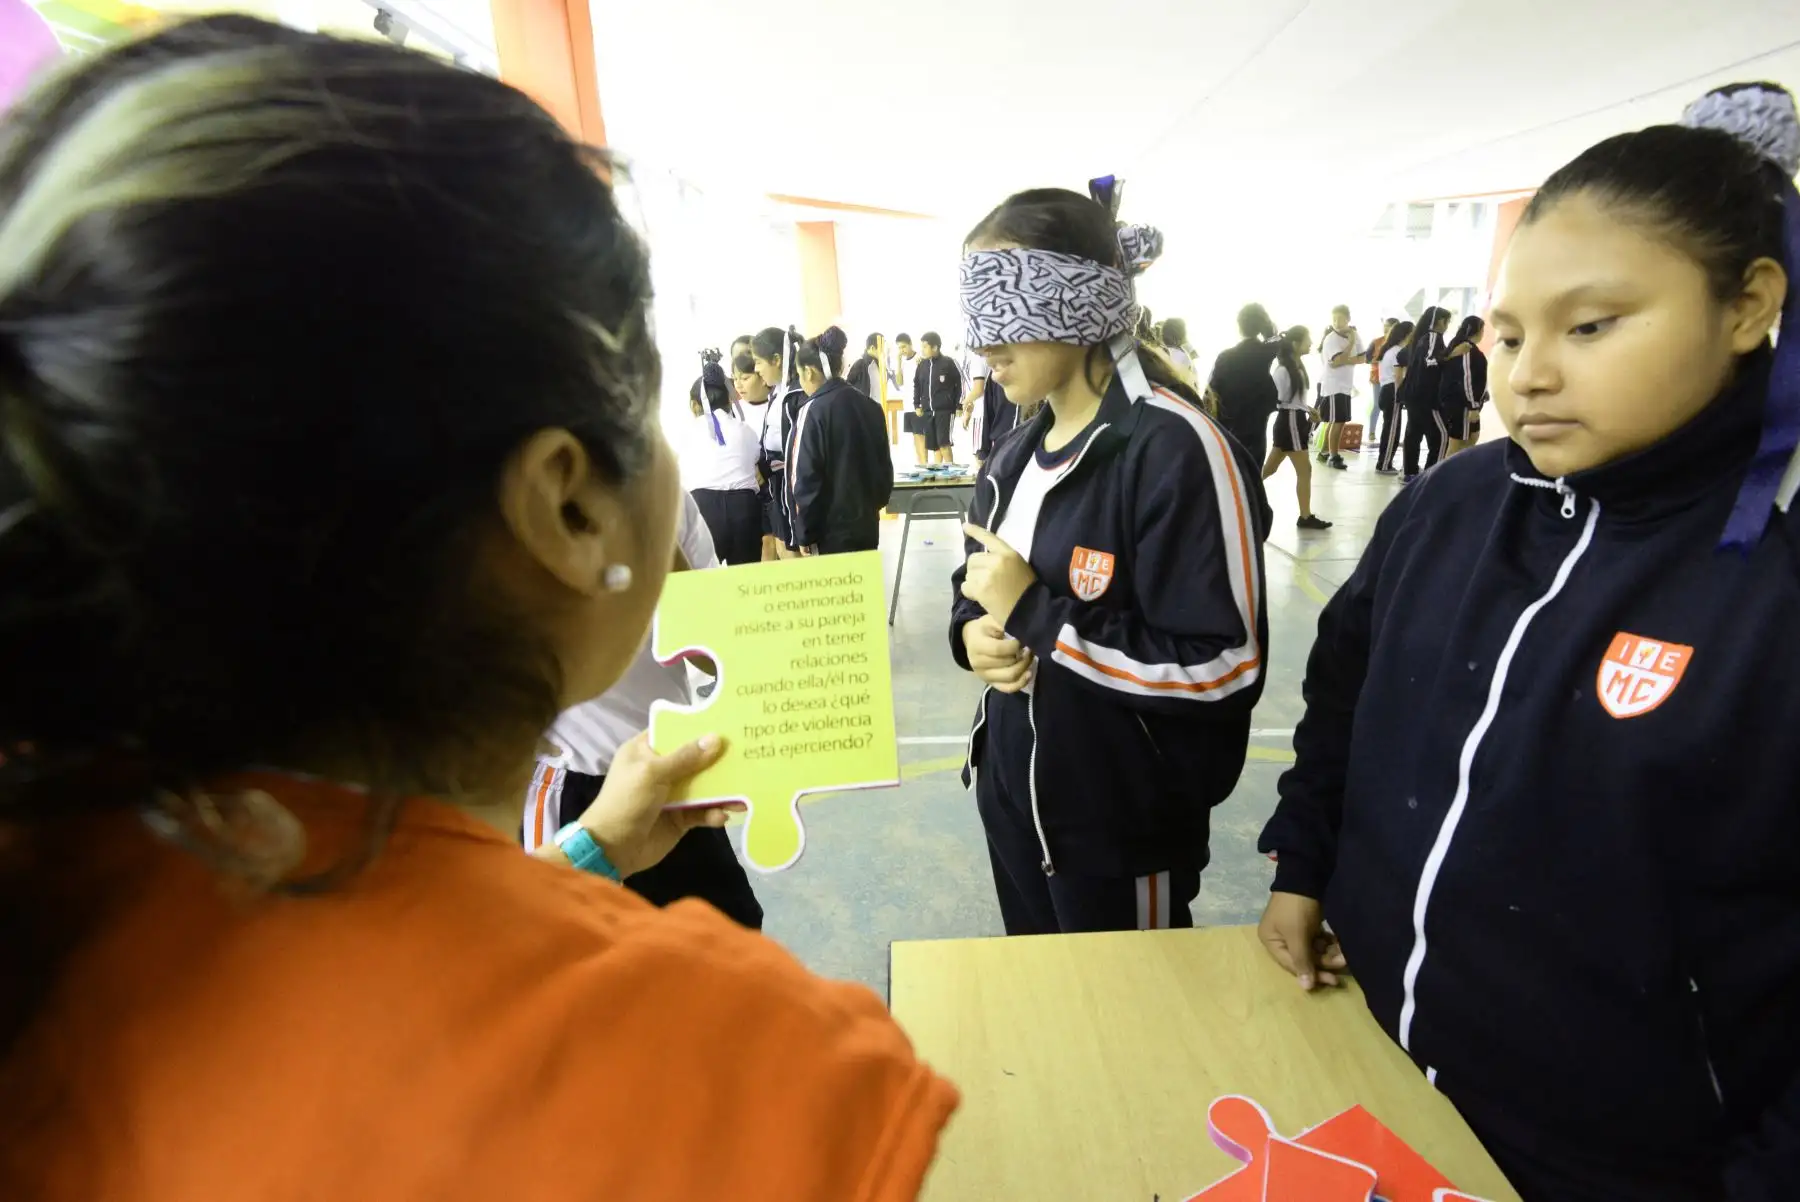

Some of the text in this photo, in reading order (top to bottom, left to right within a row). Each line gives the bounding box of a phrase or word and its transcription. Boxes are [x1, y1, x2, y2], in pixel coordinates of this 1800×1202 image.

[737, 572, 863, 597] Si un enamorado
[1077, 571, 1102, 595] MC
[777, 590, 864, 611] enamorada
[735, 620, 781, 636] insiste
[798, 618, 814, 629] su
[818, 611, 865, 630] pareja
[802, 631, 866, 648] en tener
[790, 651, 868, 669] relaciones
[736, 671, 869, 696] cuando ella/él no
[1606, 669, 1657, 705] MC
[763, 688, 870, 714] lo desea ¿qué
[744, 713, 872, 740] tipo de violencia
[744, 732, 873, 759] está ejerciendo?
